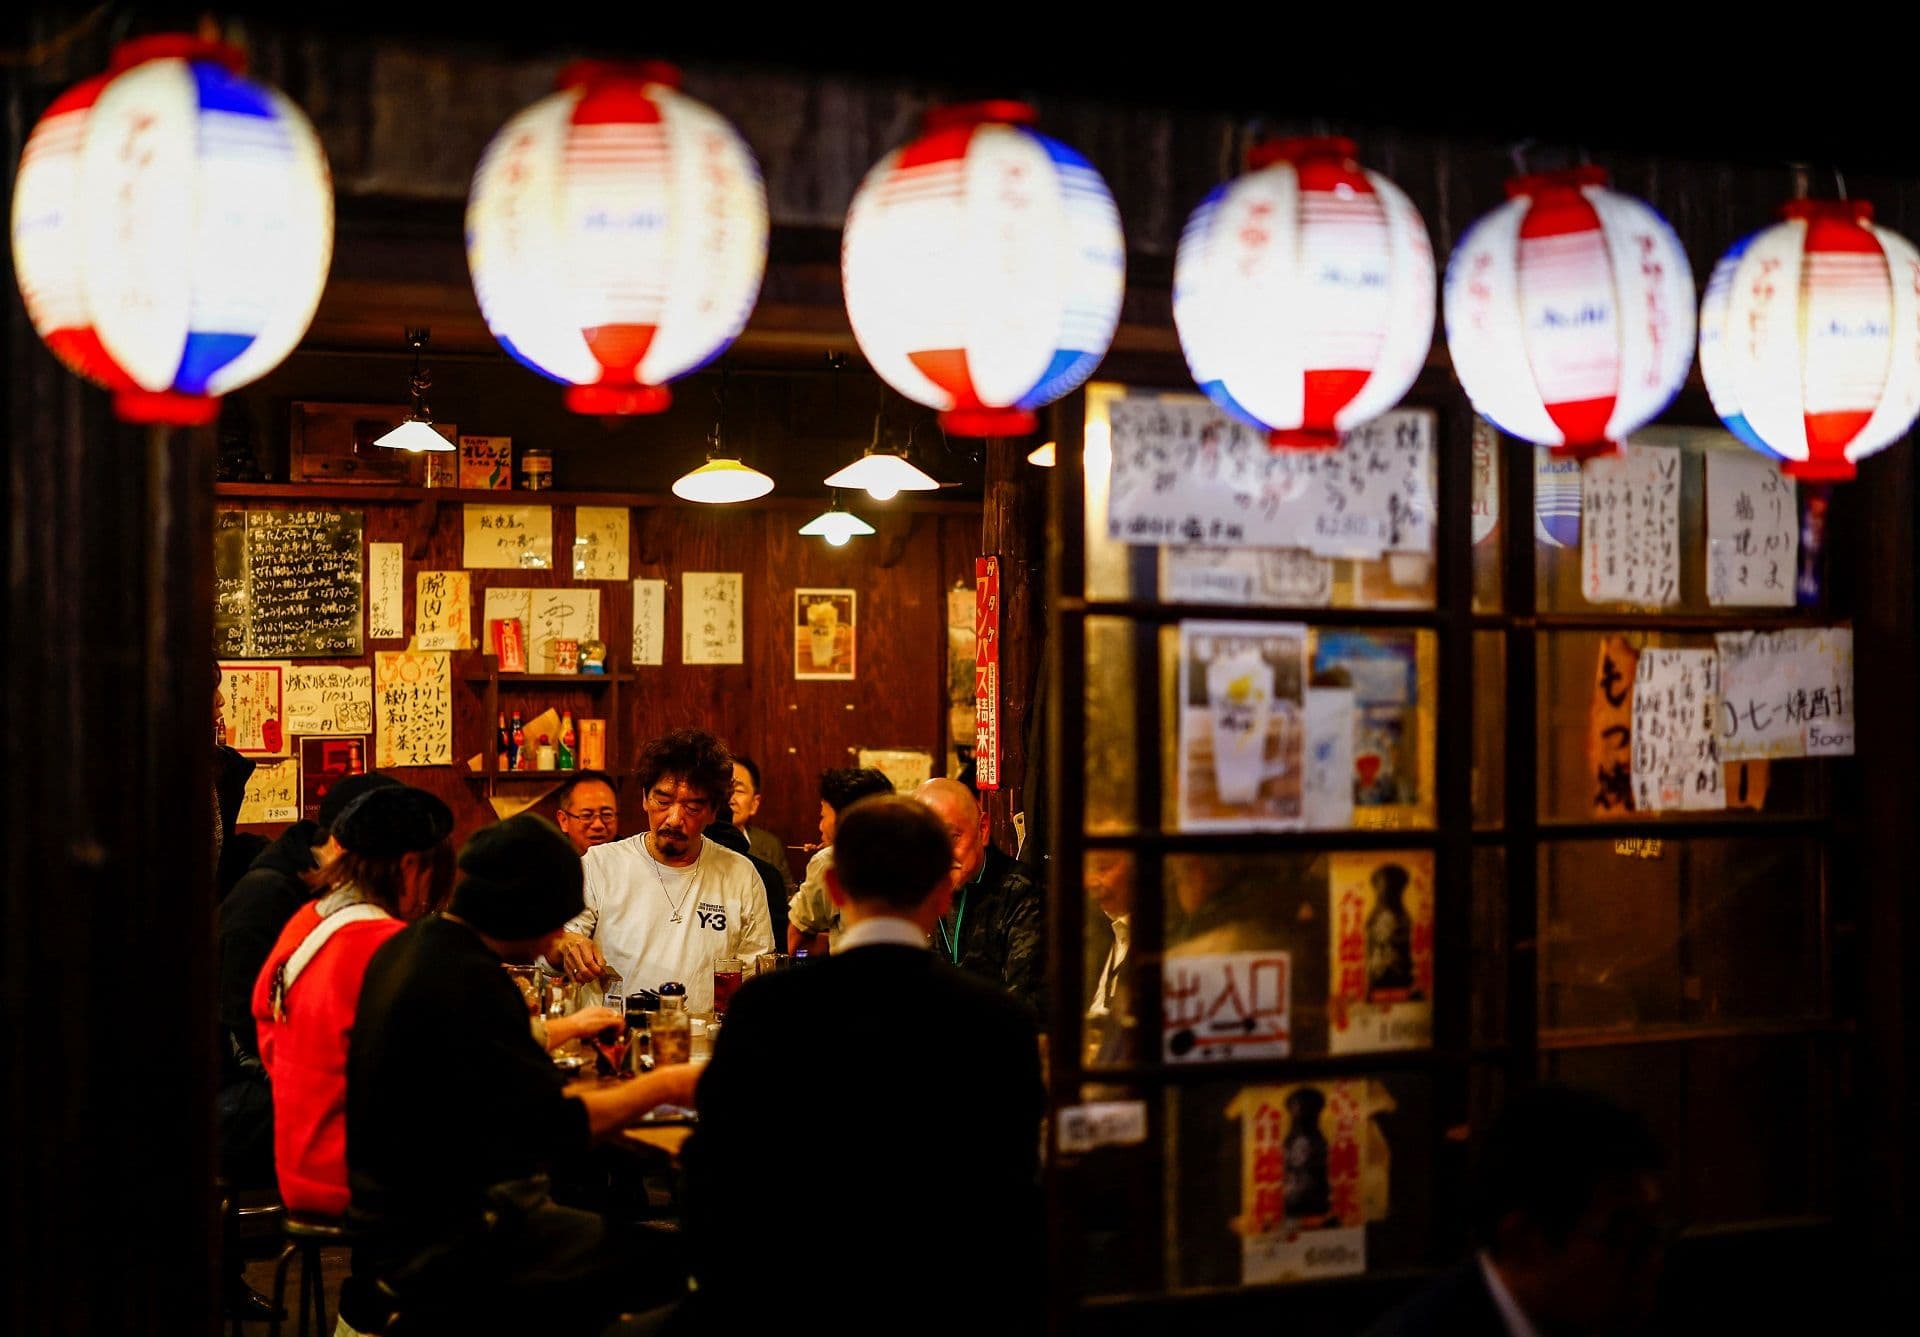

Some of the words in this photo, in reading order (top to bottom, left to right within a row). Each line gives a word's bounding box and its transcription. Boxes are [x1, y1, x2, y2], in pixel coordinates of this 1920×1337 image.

[395, 688, 409, 751] ウーロン茶
[433, 655, 448, 759] ソフトドリンク
[697, 911, 727, 931] Y-3
[1163, 957, 1289, 1028] 出入口
